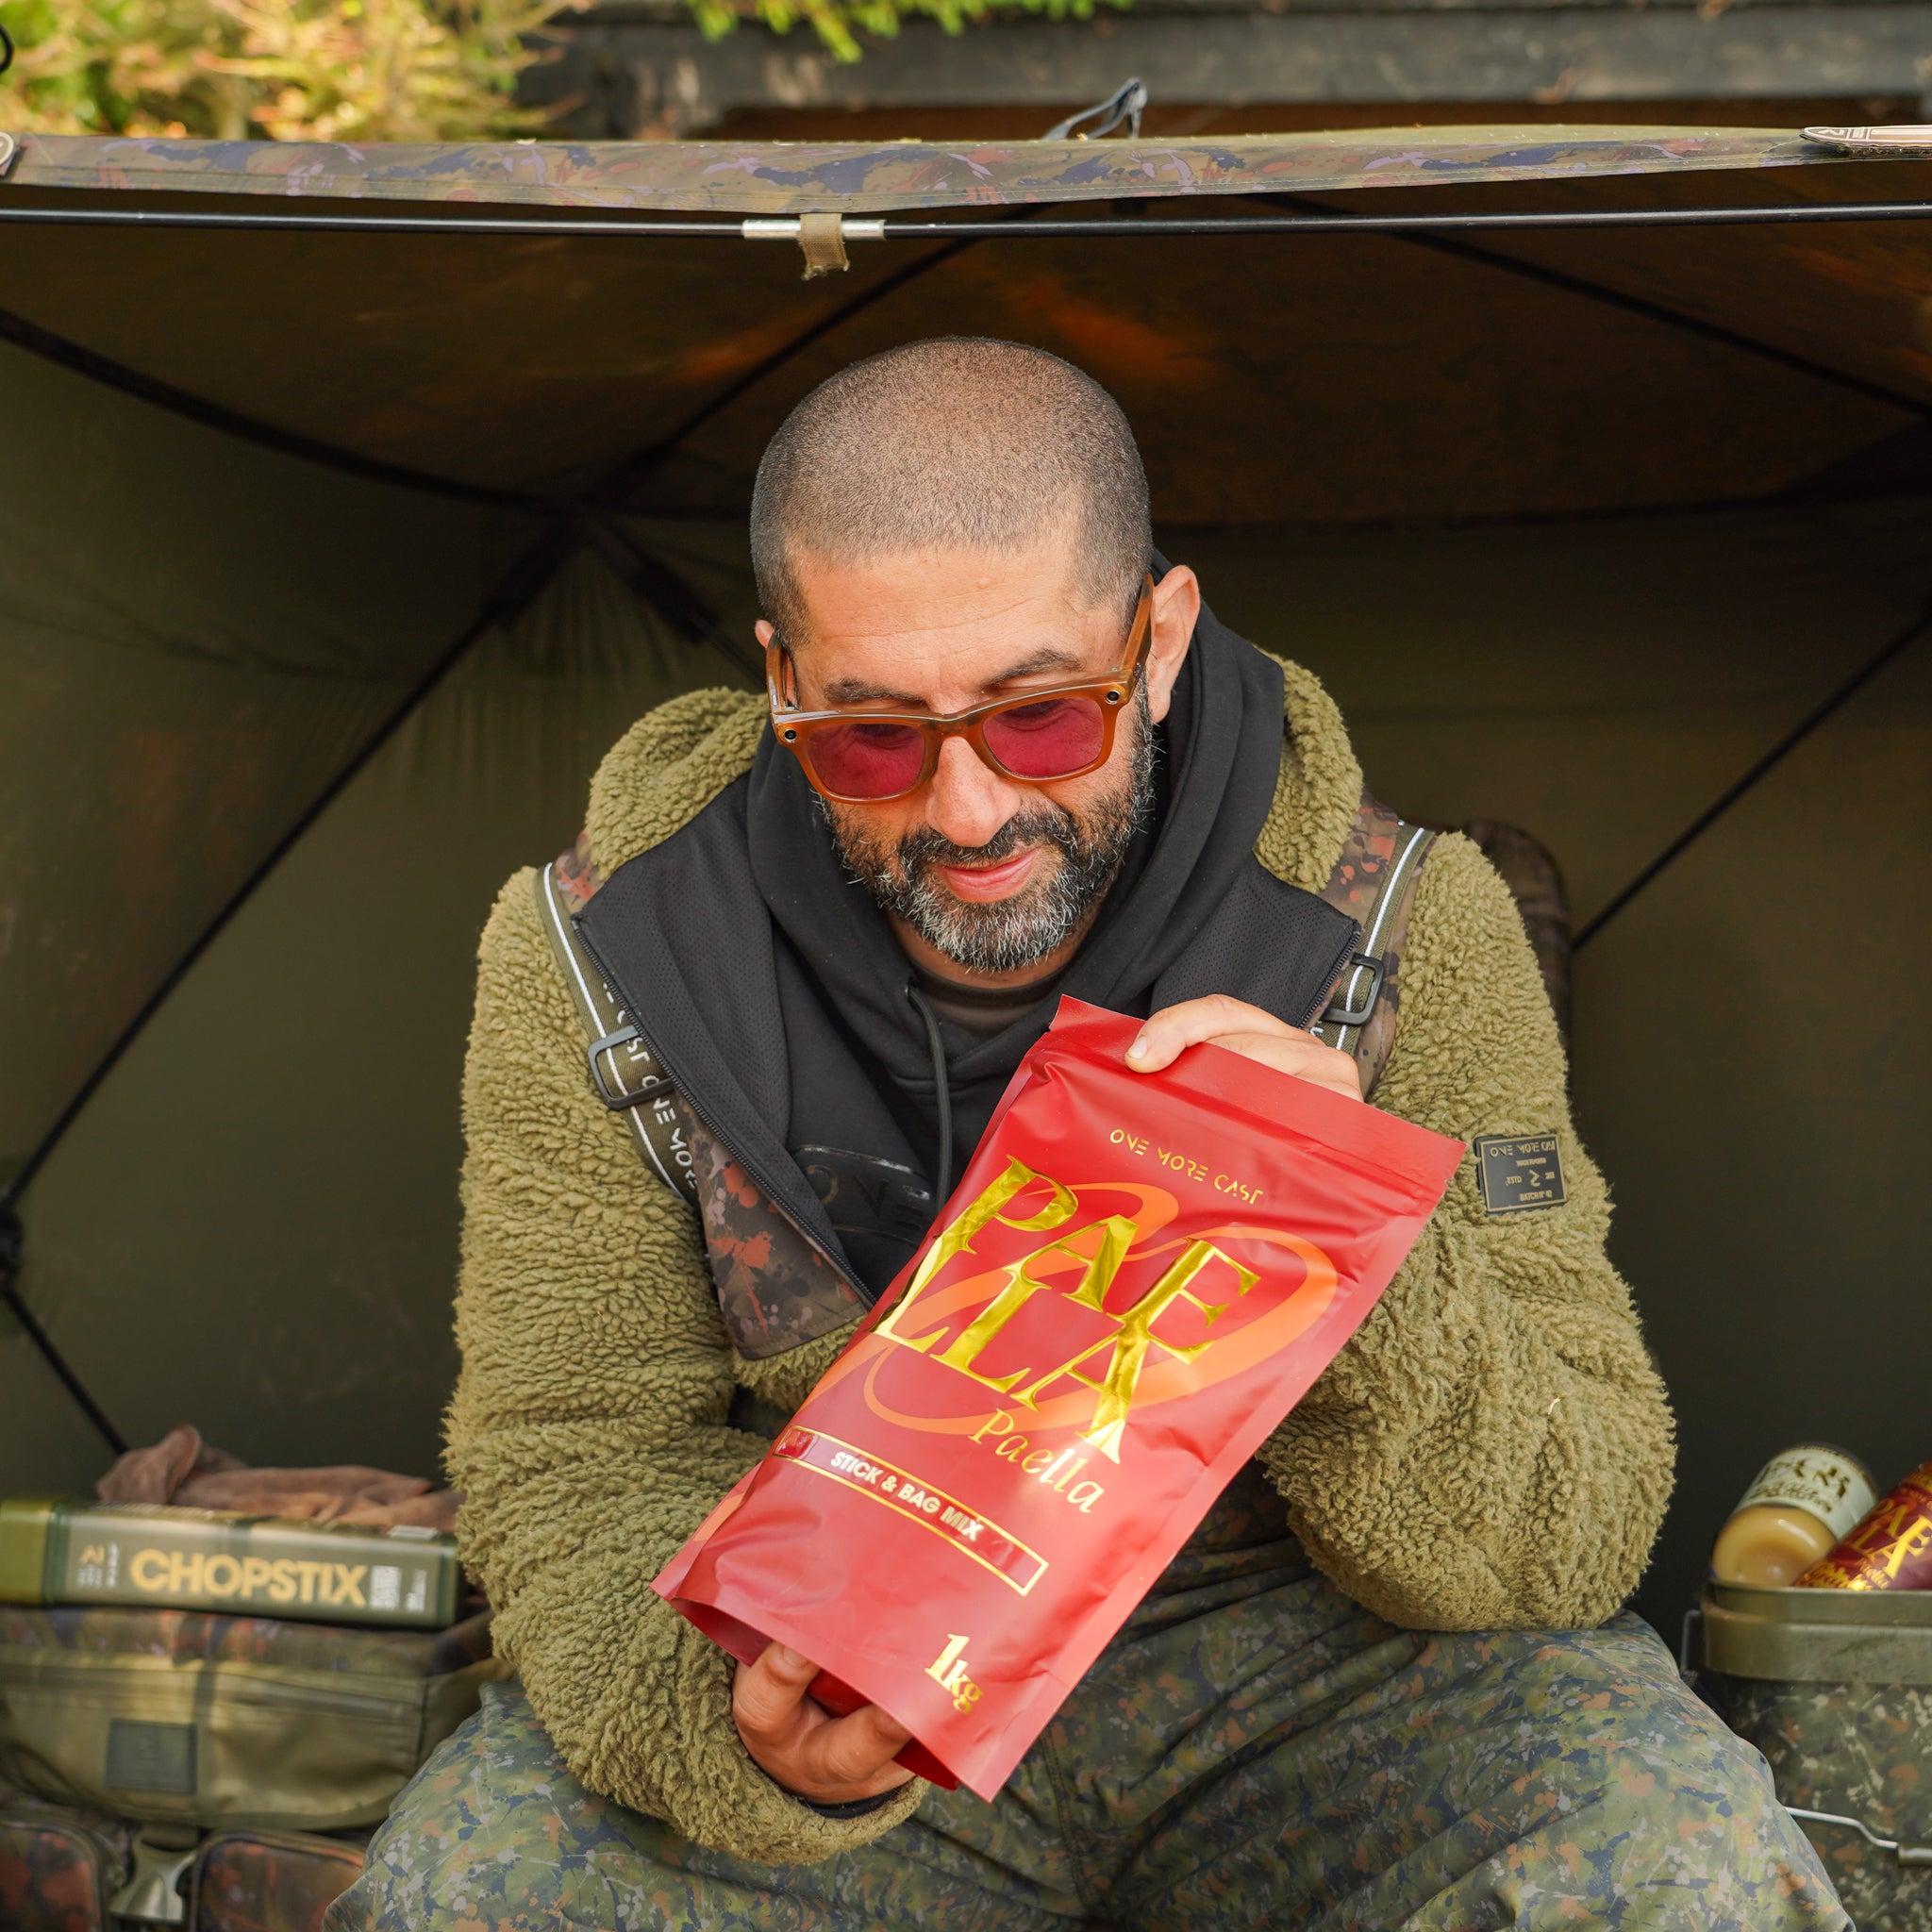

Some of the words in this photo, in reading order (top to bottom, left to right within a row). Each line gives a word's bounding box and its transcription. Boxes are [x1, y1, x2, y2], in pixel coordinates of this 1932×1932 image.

[1109, 1128, 1150, 1156] ONE
[1157, 1146, 1208, 1182] MORE
[1213, 1174, 1263, 1205] CAST
[830, 1451, 885, 1485] STICK
[881, 1474, 898, 1493] &
[897, 1483, 941, 1514] BAG
[940, 1506, 984, 1541] MIX
[968, 1408, 1105, 1514] Paella
[129, 1547, 368, 1607] CHOPSTIX
[924, 1633, 984, 1715] 1kg
